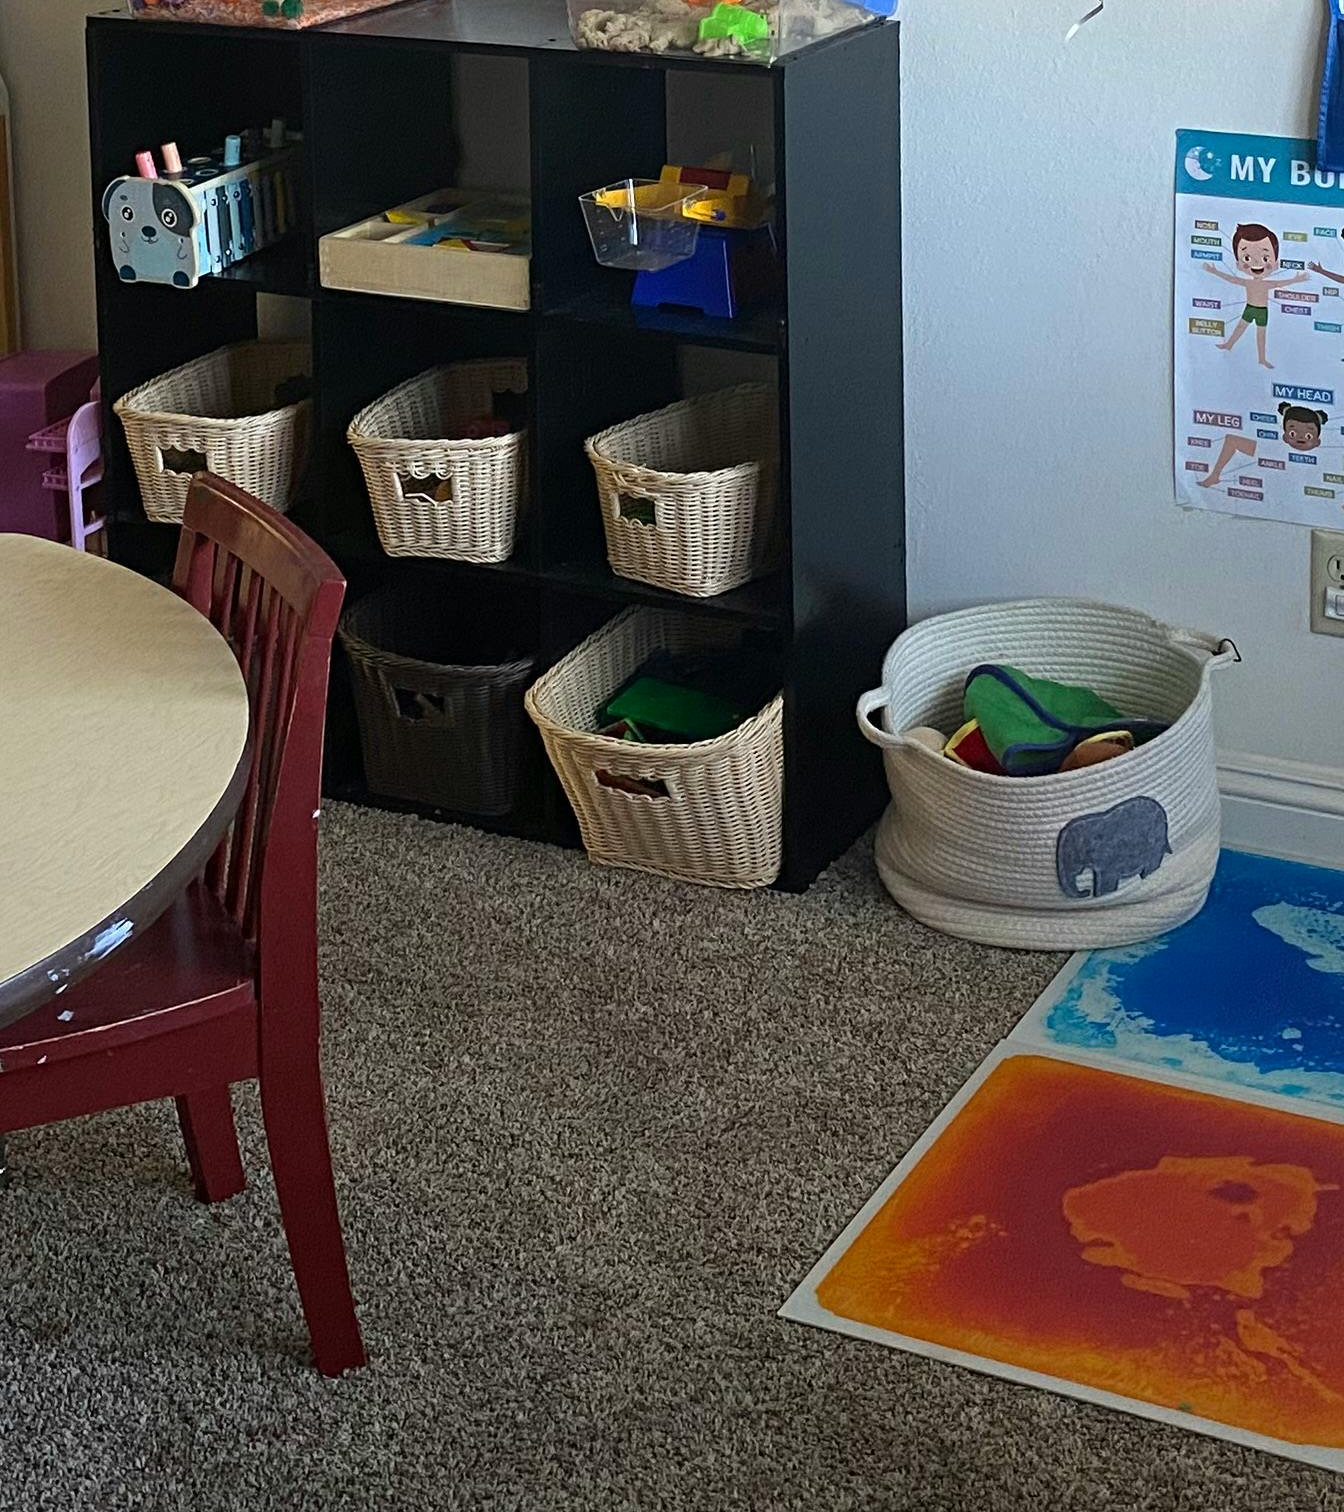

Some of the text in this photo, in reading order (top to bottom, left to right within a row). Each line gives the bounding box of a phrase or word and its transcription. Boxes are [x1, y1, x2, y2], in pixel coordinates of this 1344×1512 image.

[1230, 153, 1277, 184] MY
[1275, 385, 1332, 402] MY HEAD
[1196, 411, 1217, 424] MY
[1217, 414, 1240, 428] LEG
